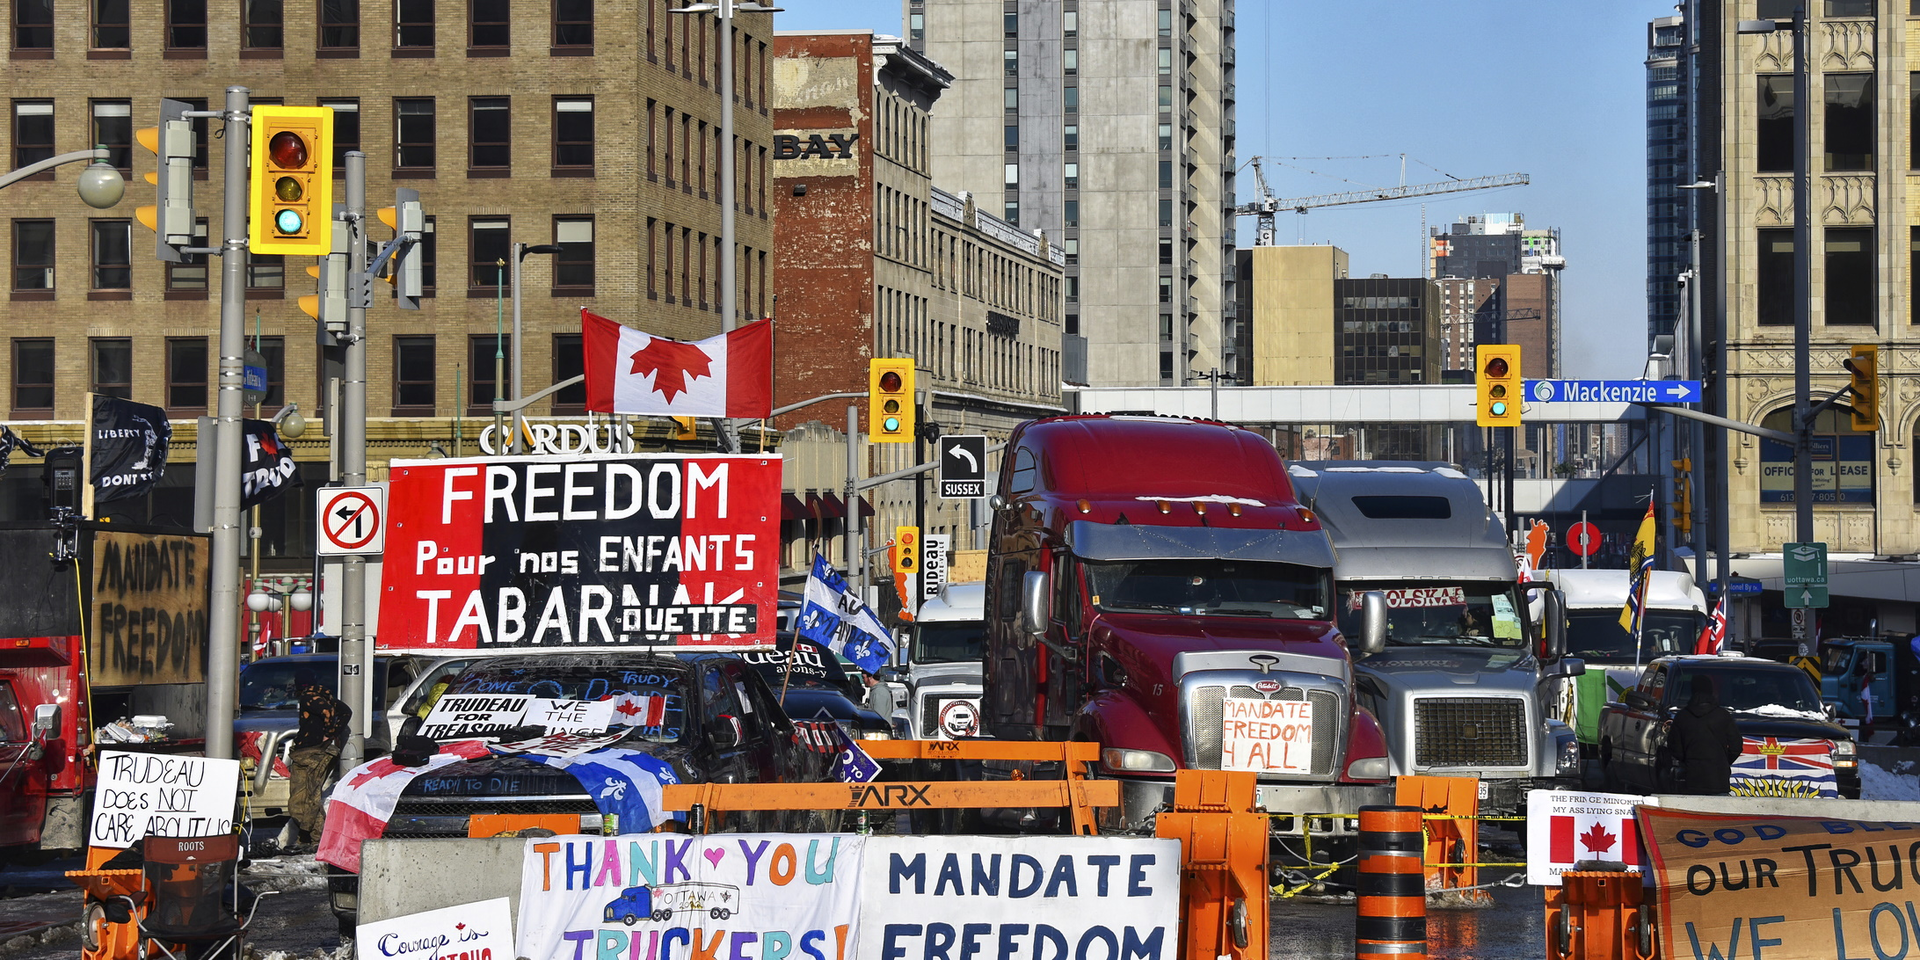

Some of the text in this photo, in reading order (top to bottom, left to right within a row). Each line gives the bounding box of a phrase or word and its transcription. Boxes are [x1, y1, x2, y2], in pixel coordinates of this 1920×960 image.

[773, 134, 859, 159] BAY
[1564, 381, 1657, 402] Mackenzie
[480, 416, 635, 455] CARDUS
[102, 473, 137, 488] DONT
[1764, 466, 1795, 476] OFFIC
[1830, 465, 1868, 475] LEASE
[442, 462, 729, 525] FREEDOM
[945, 484, 981, 495] SUSSEX
[416, 534, 756, 575] Pour nos ENFANTS
[98, 540, 196, 598] MANDATE
[1787, 576, 1825, 584] uottawa.ca
[838, 594, 863, 616] AU
[1386, 588, 1453, 608] OLSKA
[100, 601, 207, 680] FREEDOM
[618, 671, 679, 688] TRUDY
[776, 664, 827, 678] alons-y
[1152, 683, 1164, 696] 15
[440, 698, 528, 713] TRUDEAU
[550, 701, 588, 712] WE
[1224, 702, 1311, 718] MANDATE
[453, 713, 493, 722] FOR
[545, 711, 587, 723] THE
[1223, 720, 1312, 743] FREEDOM
[1223, 741, 1298, 769] 4 ALL
[106, 754, 205, 787] TRUDEAU
[851, 765, 864, 779] TO
[465, 778, 483, 791] TO
[491, 777, 521, 792] DIE
[858, 784, 932, 806] ARX
[103, 787, 198, 812] DOES NOT
[1586, 807, 1613, 815] LYING
[95, 813, 135, 842] CARE
[1676, 825, 1787, 848] GOD
[178, 841, 205, 852] ROOTS
[533, 836, 841, 891] THANK YOU
[889, 853, 1156, 898] MANDATE
[1686, 858, 1779, 896] OUR
[664, 890, 716, 904] OTTAWA
[378, 932, 450, 960] Courage
[457, 926, 489, 943] is
